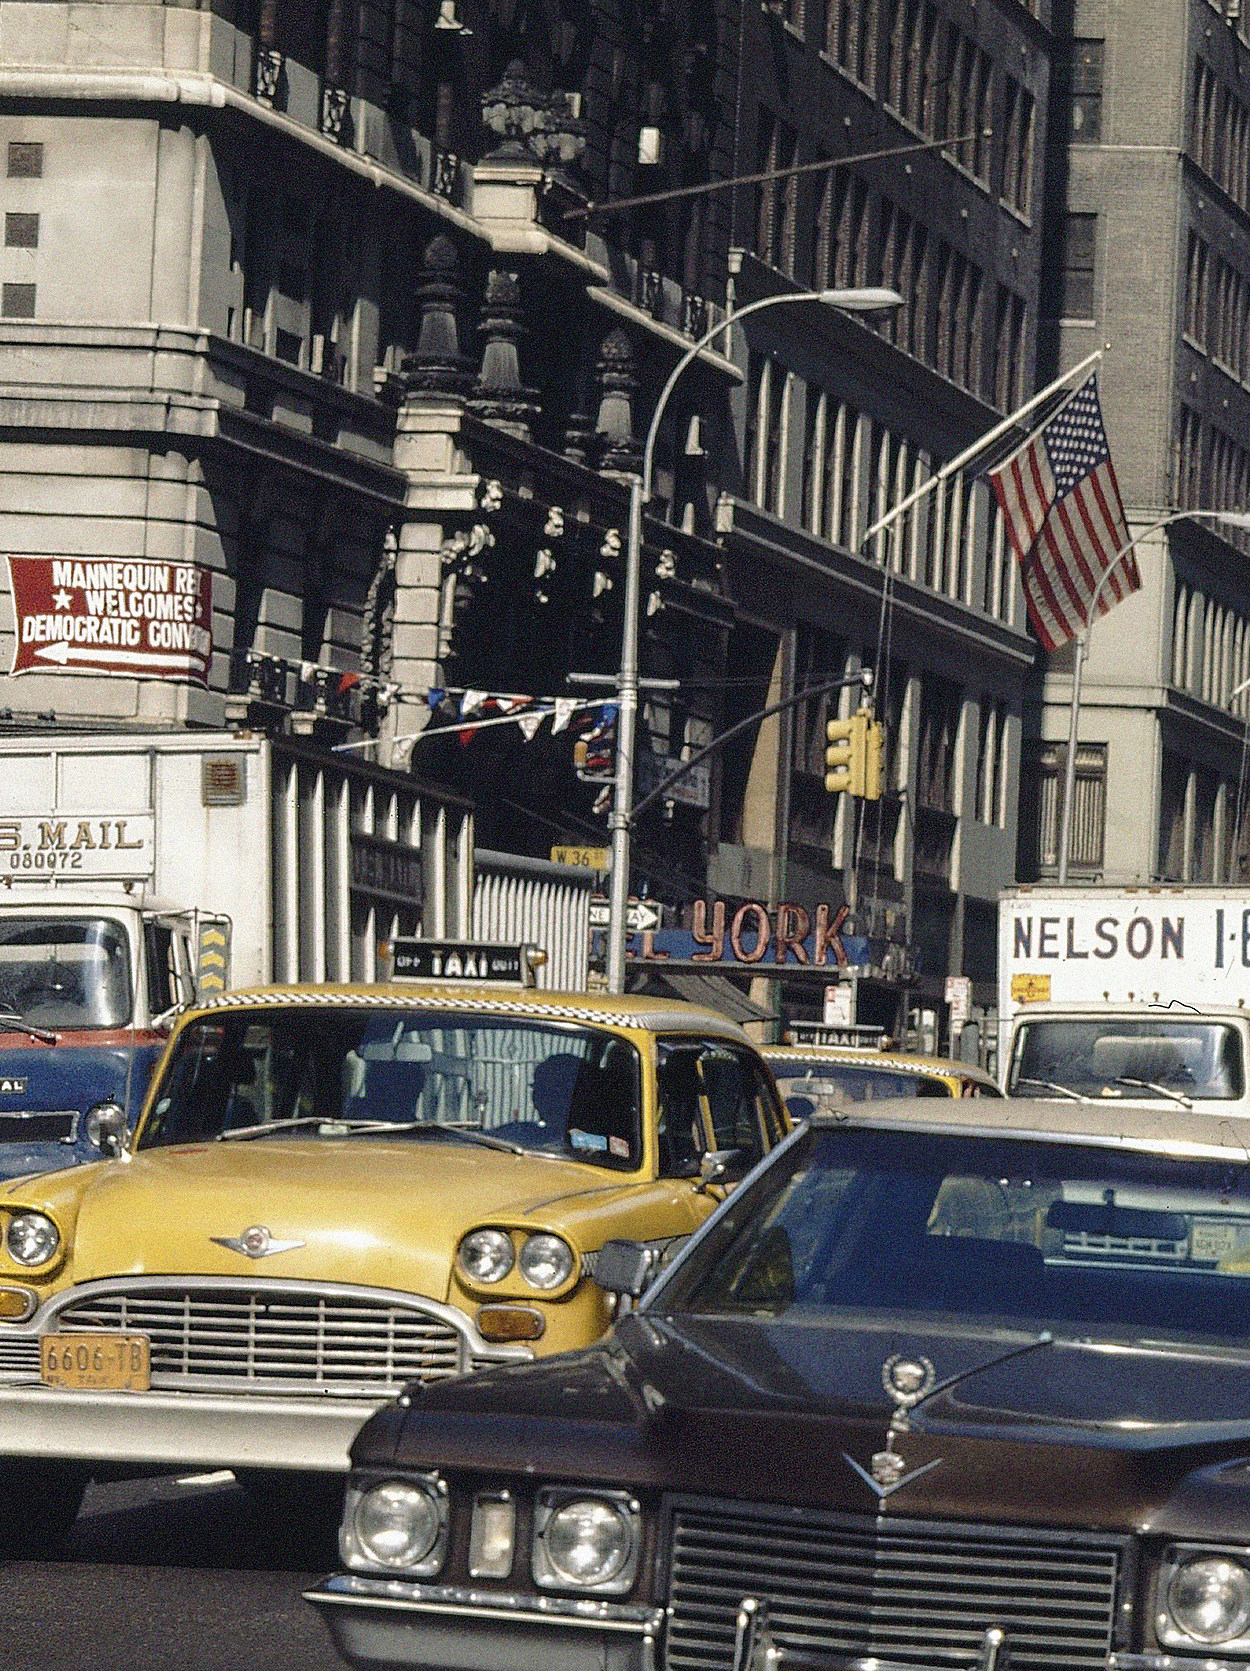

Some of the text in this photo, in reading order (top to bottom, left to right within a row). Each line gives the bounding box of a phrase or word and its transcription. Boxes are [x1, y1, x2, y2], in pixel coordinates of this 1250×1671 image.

[52, 561, 170, 591] MANNEQUIN
[84, 590, 196, 623] WELCOMES
[22, 614, 141, 646] DEMOCRATIC
[37, 821, 145, 850] MAIL
[556, 849, 568, 861] W
[571, 851, 590, 867] 36
[692, 898, 850, 968] YORK
[1012, 915, 1185, 960] NELSON
[430, 950, 488, 977] TAXI
